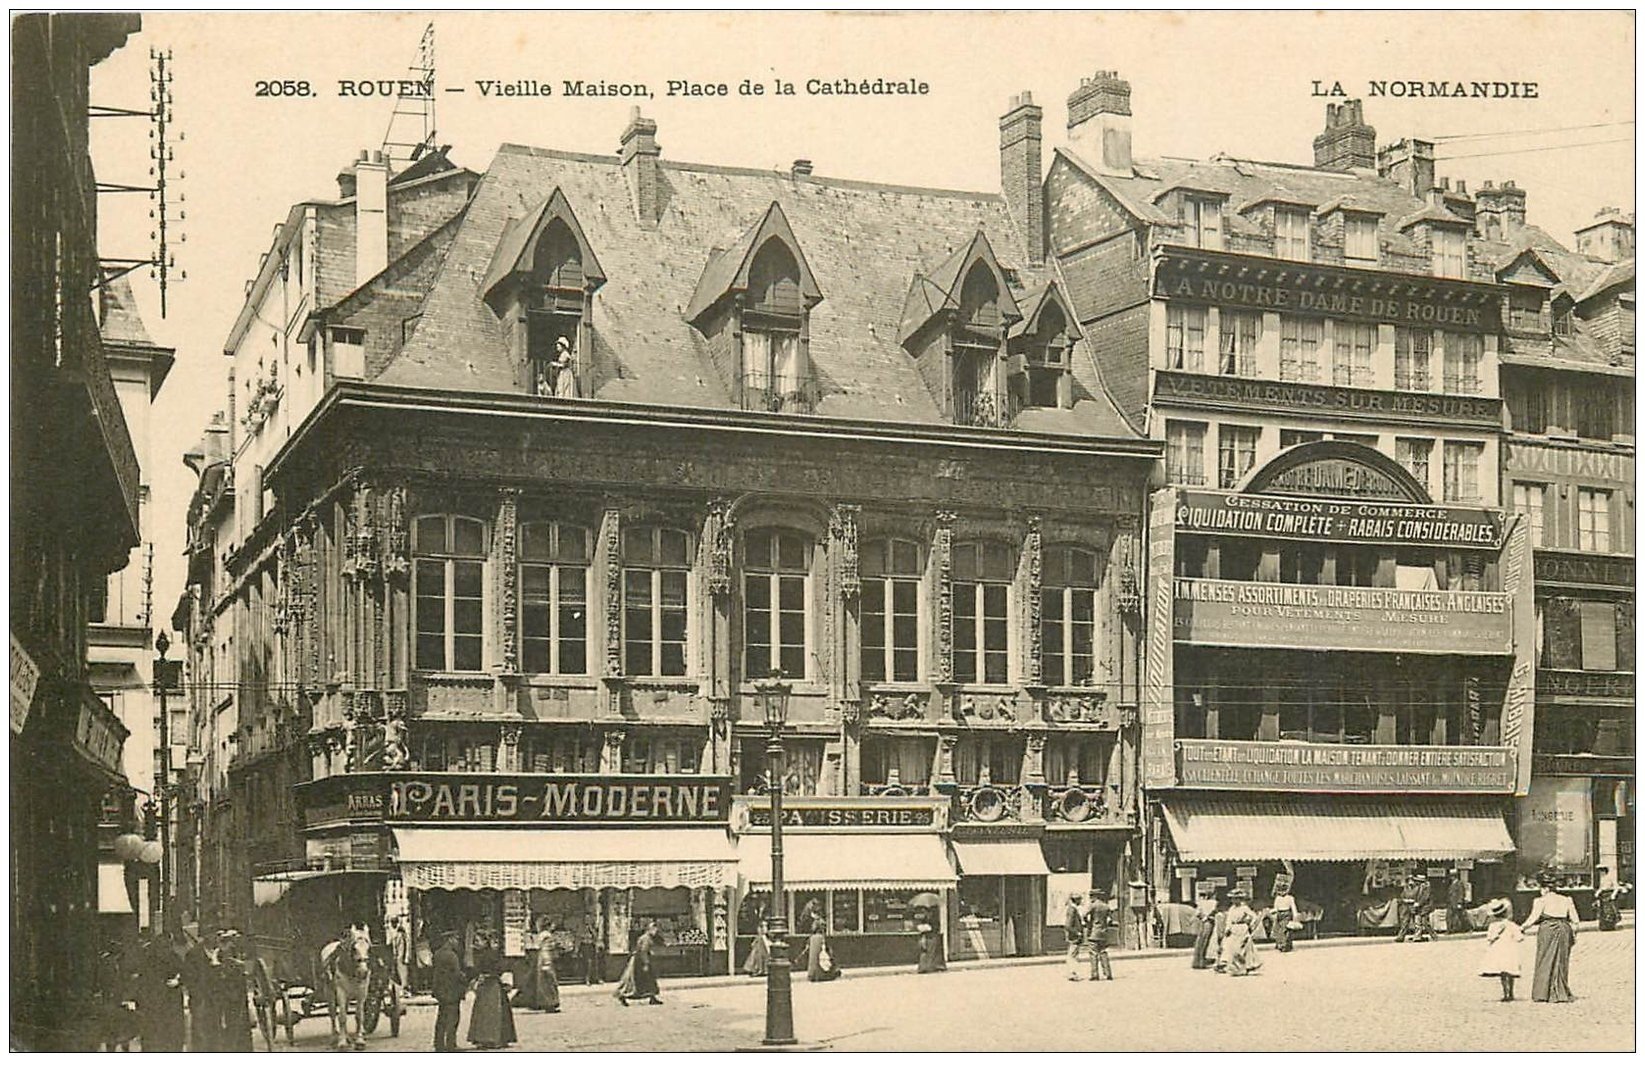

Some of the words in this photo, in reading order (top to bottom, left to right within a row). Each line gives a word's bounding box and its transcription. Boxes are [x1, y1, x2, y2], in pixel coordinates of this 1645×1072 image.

[1176, 277, 1195, 296] A
[1201, 280, 1290, 306] NOTRE
[1299, 291, 1363, 315] DAME
[1371, 300, 1399, 319] DE
[1406, 303, 1482, 326] ROUEN
[1335, 394, 1384, 412] SUR
[1391, 397, 1488, 418] MESURE
[1226, 496, 1322, 513] CESSATION
[1329, 505, 1352, 516] DE
[1358, 505, 1448, 520] COMMERCE
[1175, 505, 1263, 531] LIQUIDATION
[1348, 518, 1395, 538] RABAIS
[1174, 580, 1235, 601] IMMENSES
[1238, 585, 1318, 606] ASSORTIMENTS
[1447, 593, 1504, 613] ANGLAISES
[1231, 605, 1274, 617] POUR
[1184, 745, 1205, 762] TOUT
[1247, 747, 1299, 765] LIQUIDATION
[1301, 749, 1312, 765] LA
[1313, 749, 1348, 766] MAISON
